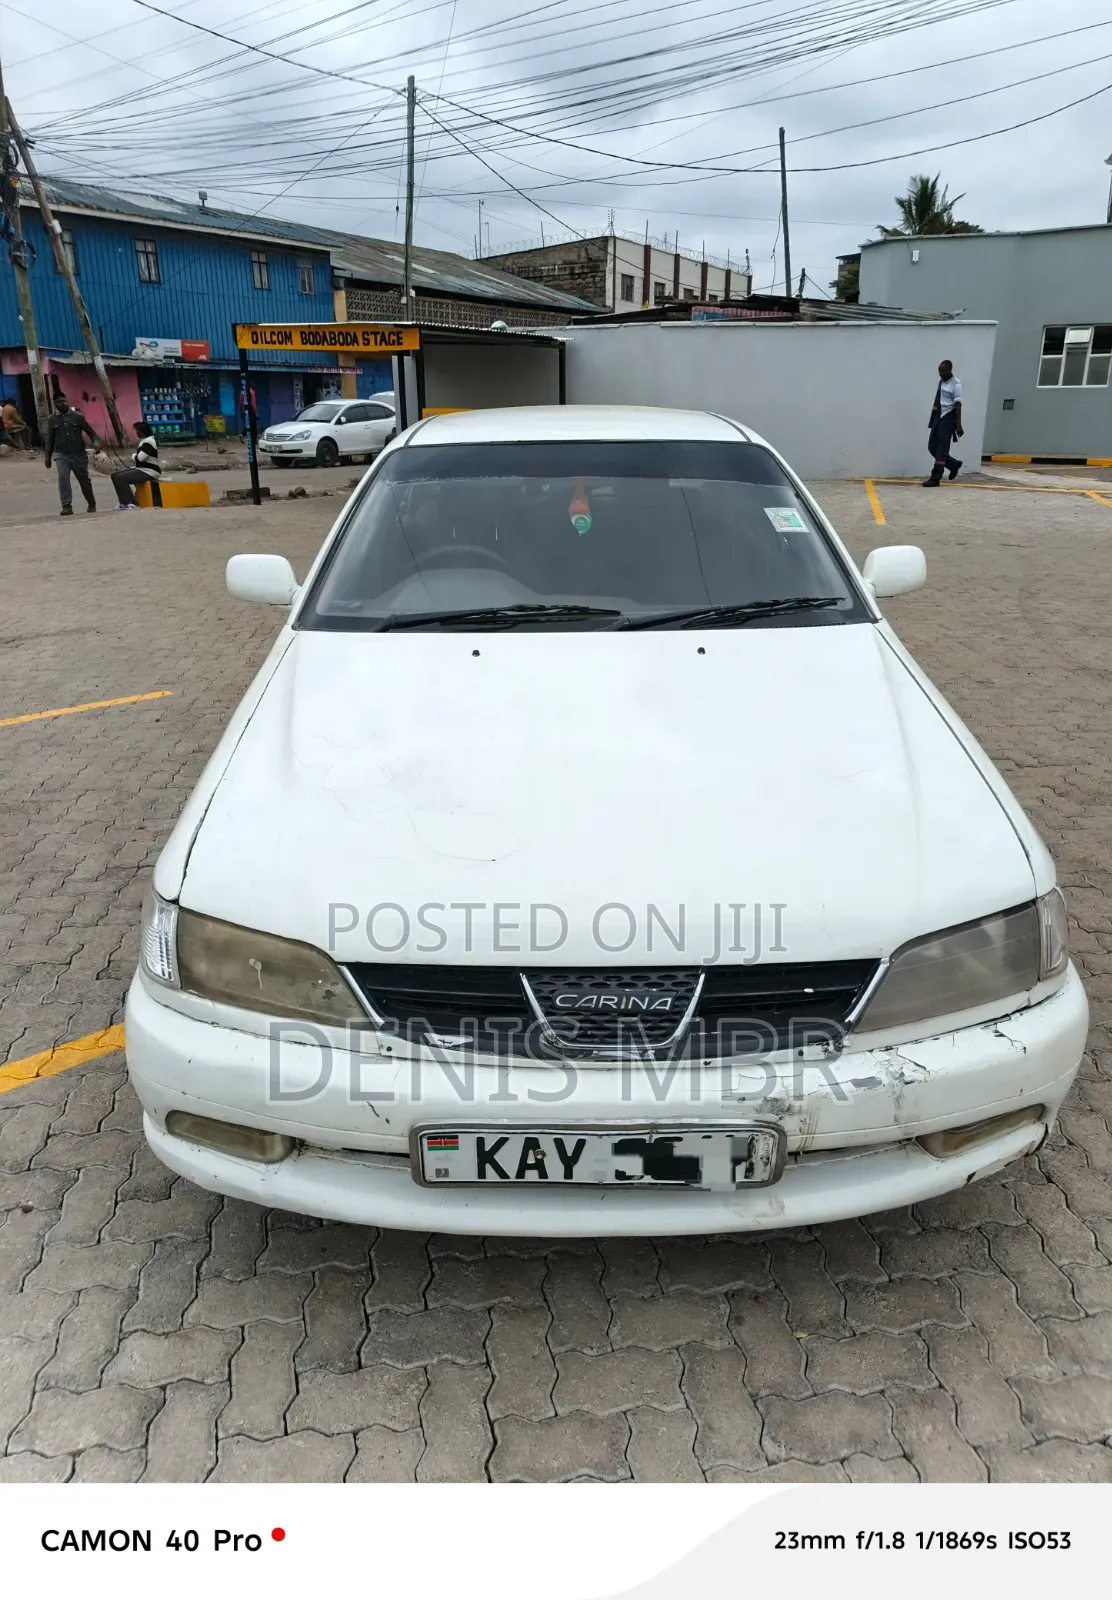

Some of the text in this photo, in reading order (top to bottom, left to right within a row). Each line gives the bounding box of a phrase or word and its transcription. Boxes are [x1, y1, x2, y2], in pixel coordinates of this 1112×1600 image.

[251, 331, 404, 347] OILCOM BODABODA STAGE
[555, 994, 673, 1011] CARINA
[475, 1136, 588, 1180] KAY
